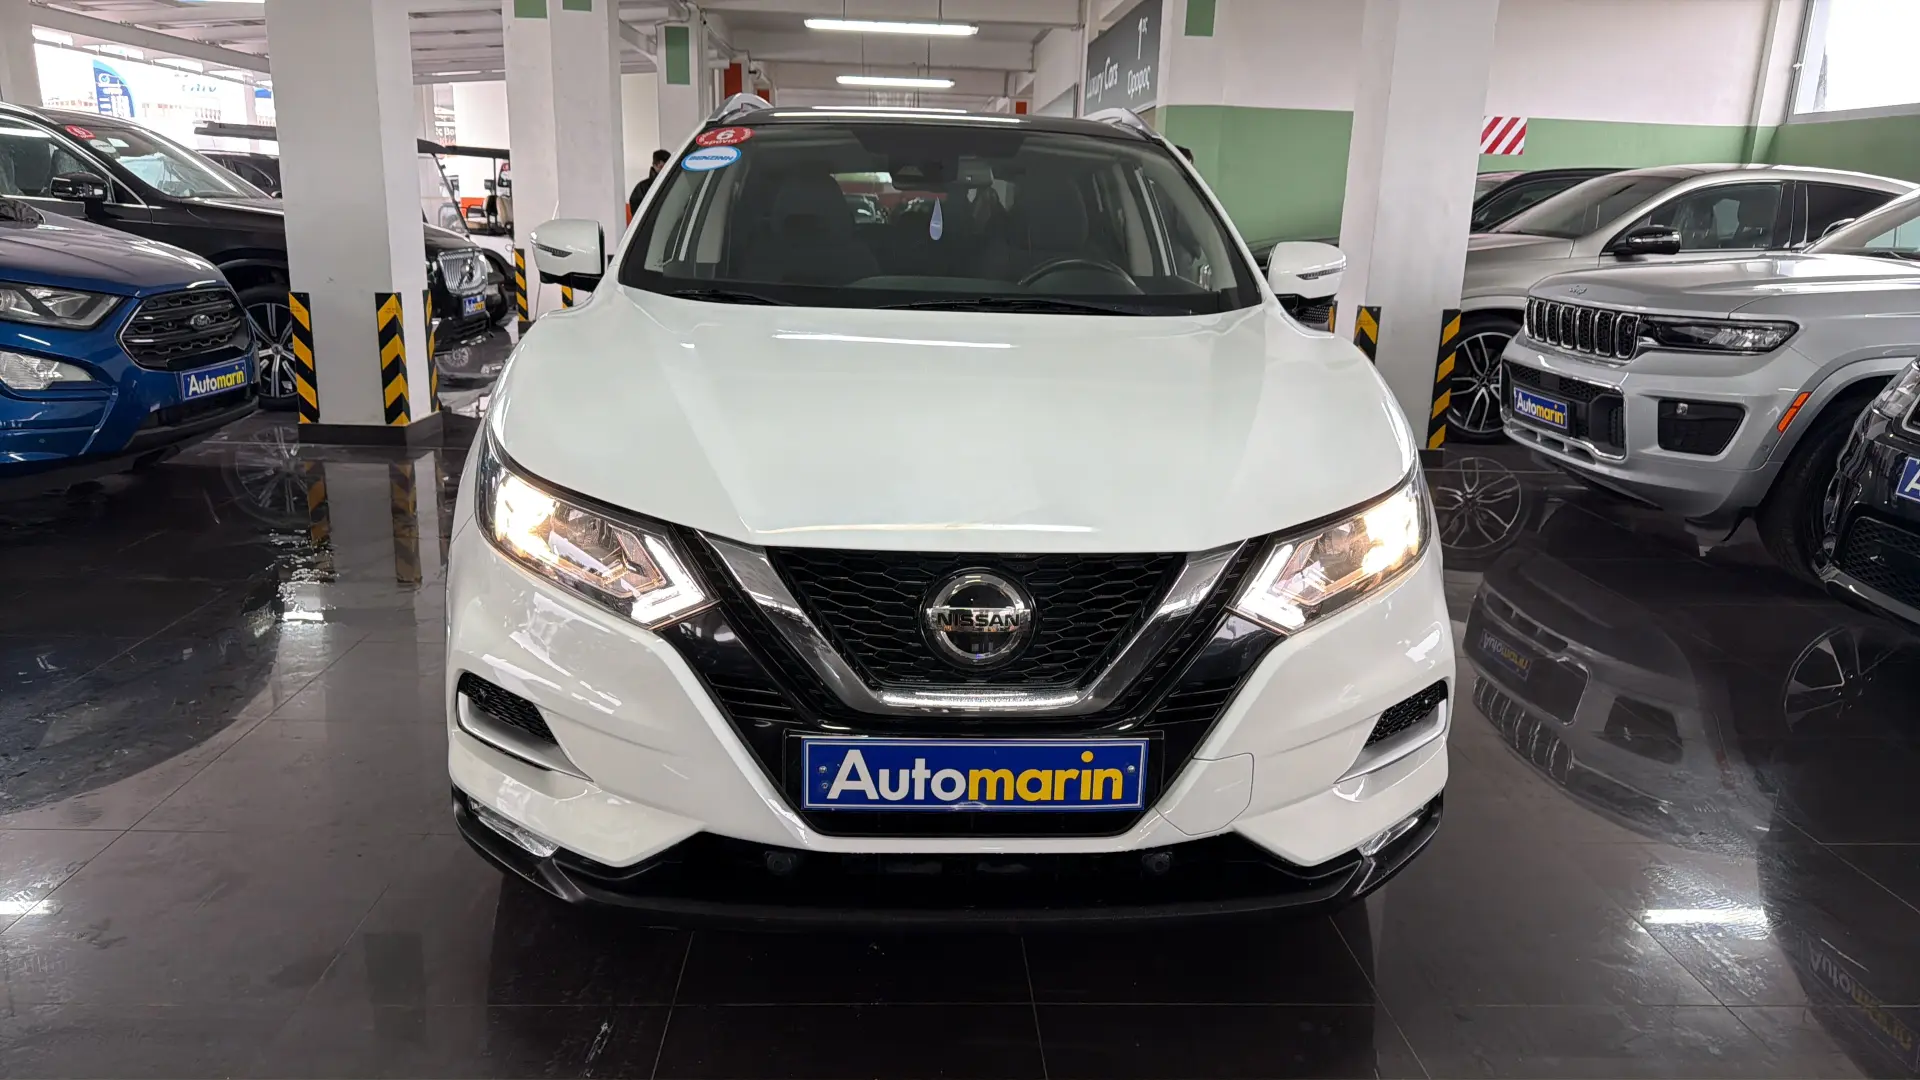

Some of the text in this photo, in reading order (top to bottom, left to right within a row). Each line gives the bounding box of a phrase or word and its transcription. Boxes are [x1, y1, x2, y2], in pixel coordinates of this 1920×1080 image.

[1104, 56, 1119, 91] Cars
[716, 129, 736, 141] 6
[188, 365, 245, 396] Automarin
[1516, 392, 1564, 425] Automarin
[937, 612, 1020, 627] NISSAN
[826, 749, 1124, 802] Automarin
